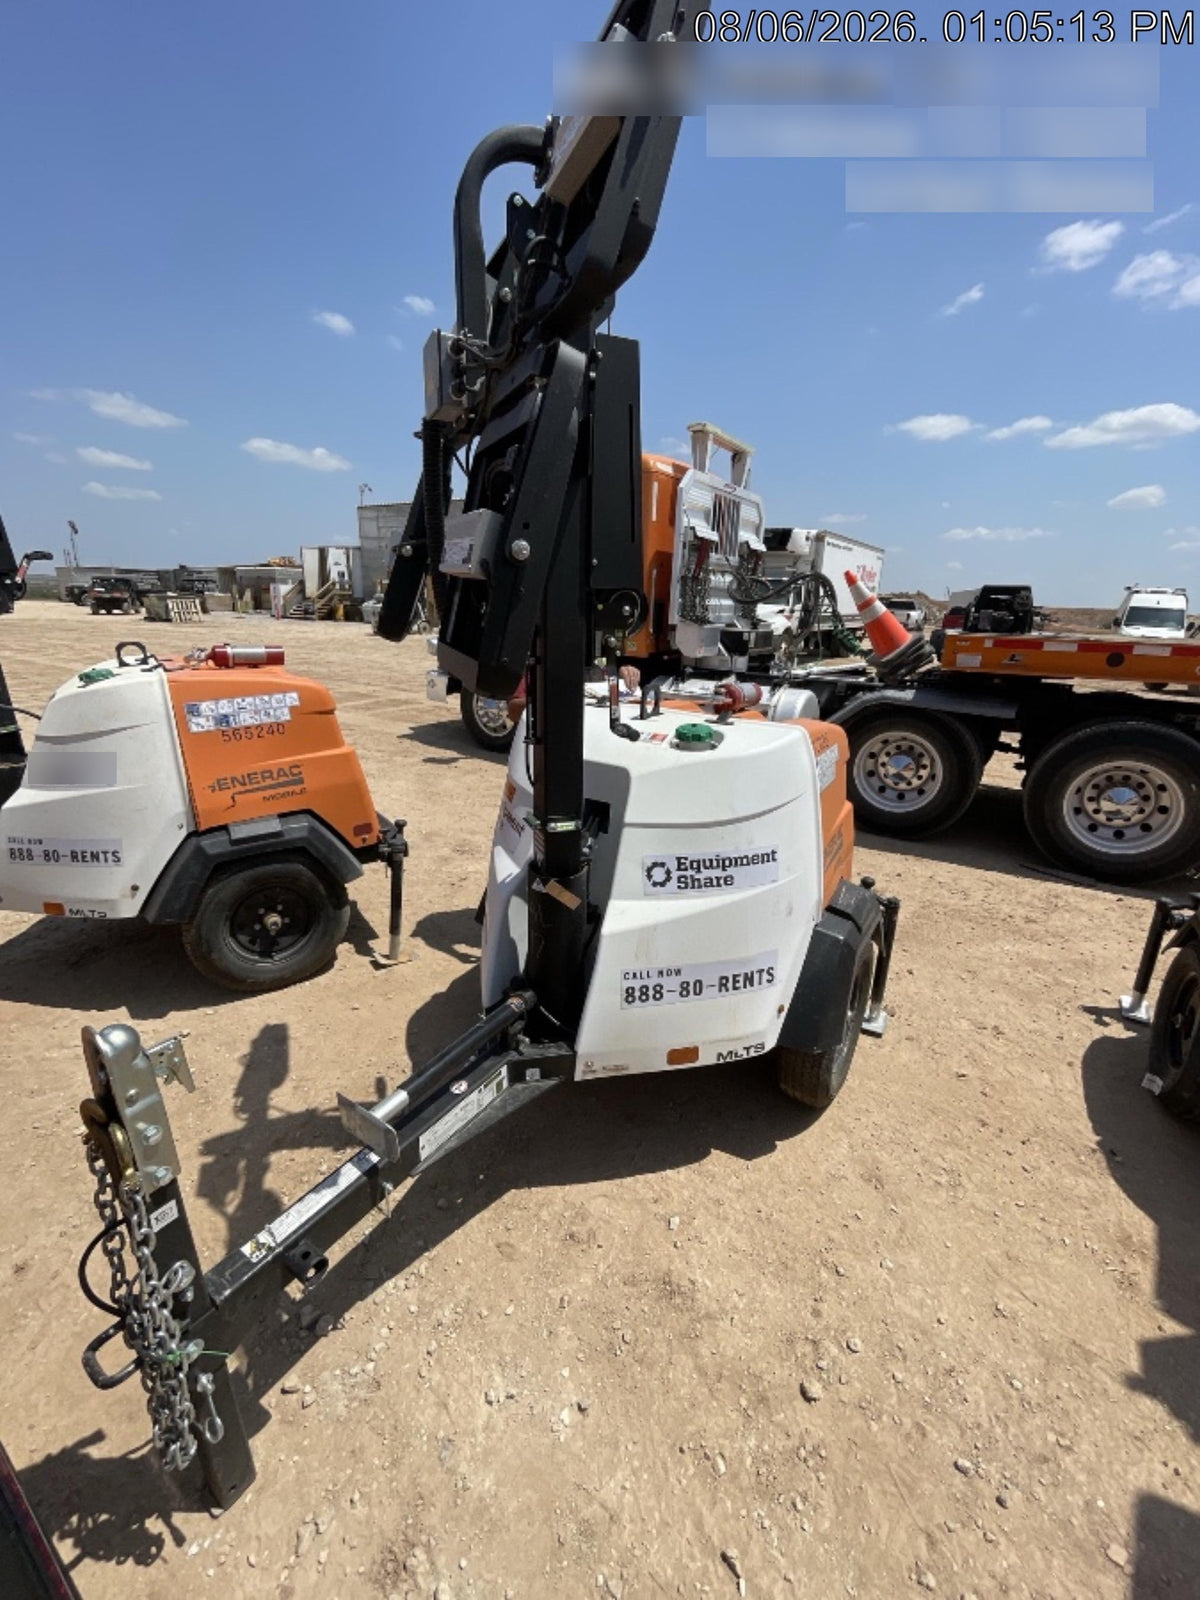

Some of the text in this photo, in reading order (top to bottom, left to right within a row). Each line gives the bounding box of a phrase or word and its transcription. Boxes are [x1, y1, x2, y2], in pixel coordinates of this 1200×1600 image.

[675, 849, 778, 874] Equipment
[677, 872, 736, 890] Share
[623, 968, 683, 981] CALL NOW
[624, 966, 776, 1005] 888-80-RENTS
